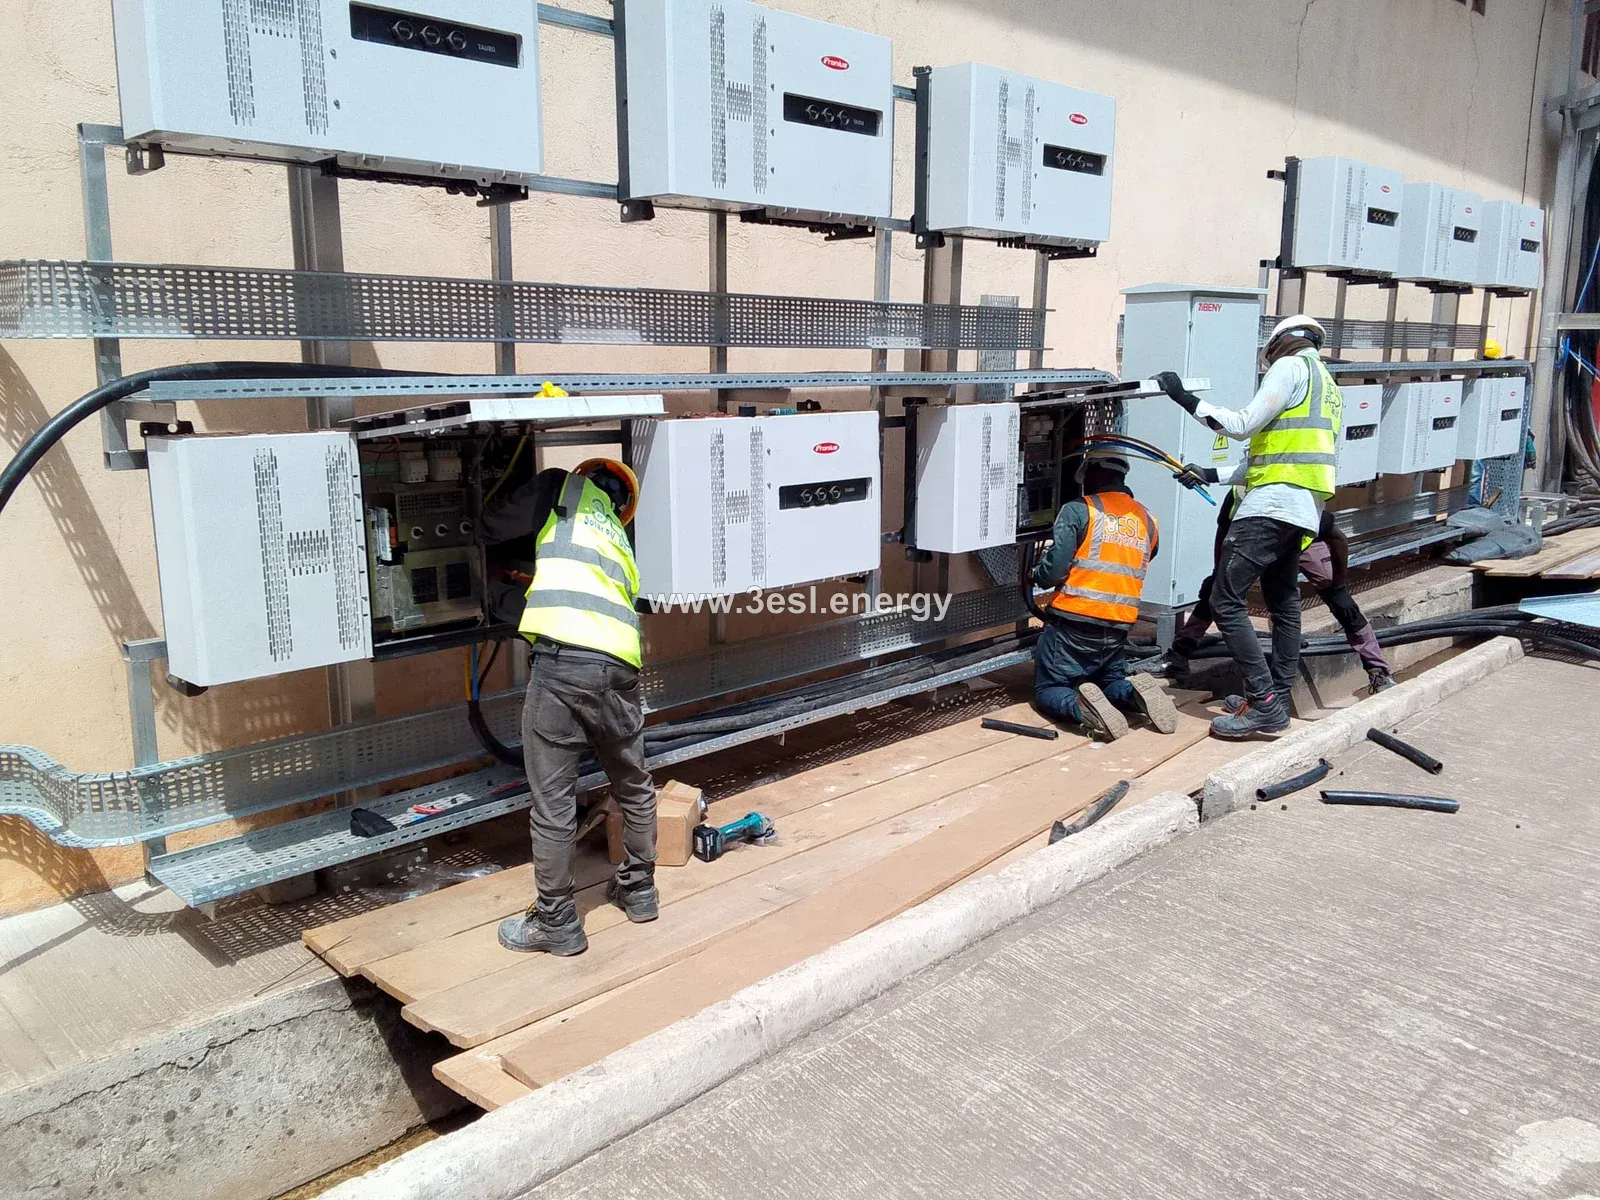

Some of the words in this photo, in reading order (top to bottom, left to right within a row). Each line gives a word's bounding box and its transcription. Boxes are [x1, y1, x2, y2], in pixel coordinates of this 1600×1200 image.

[823, 57, 848, 69] Fronius
[815, 444, 838, 452] Fronius
[584, 515, 604, 532] Solar
[1103, 514, 1144, 541] 3ESL
